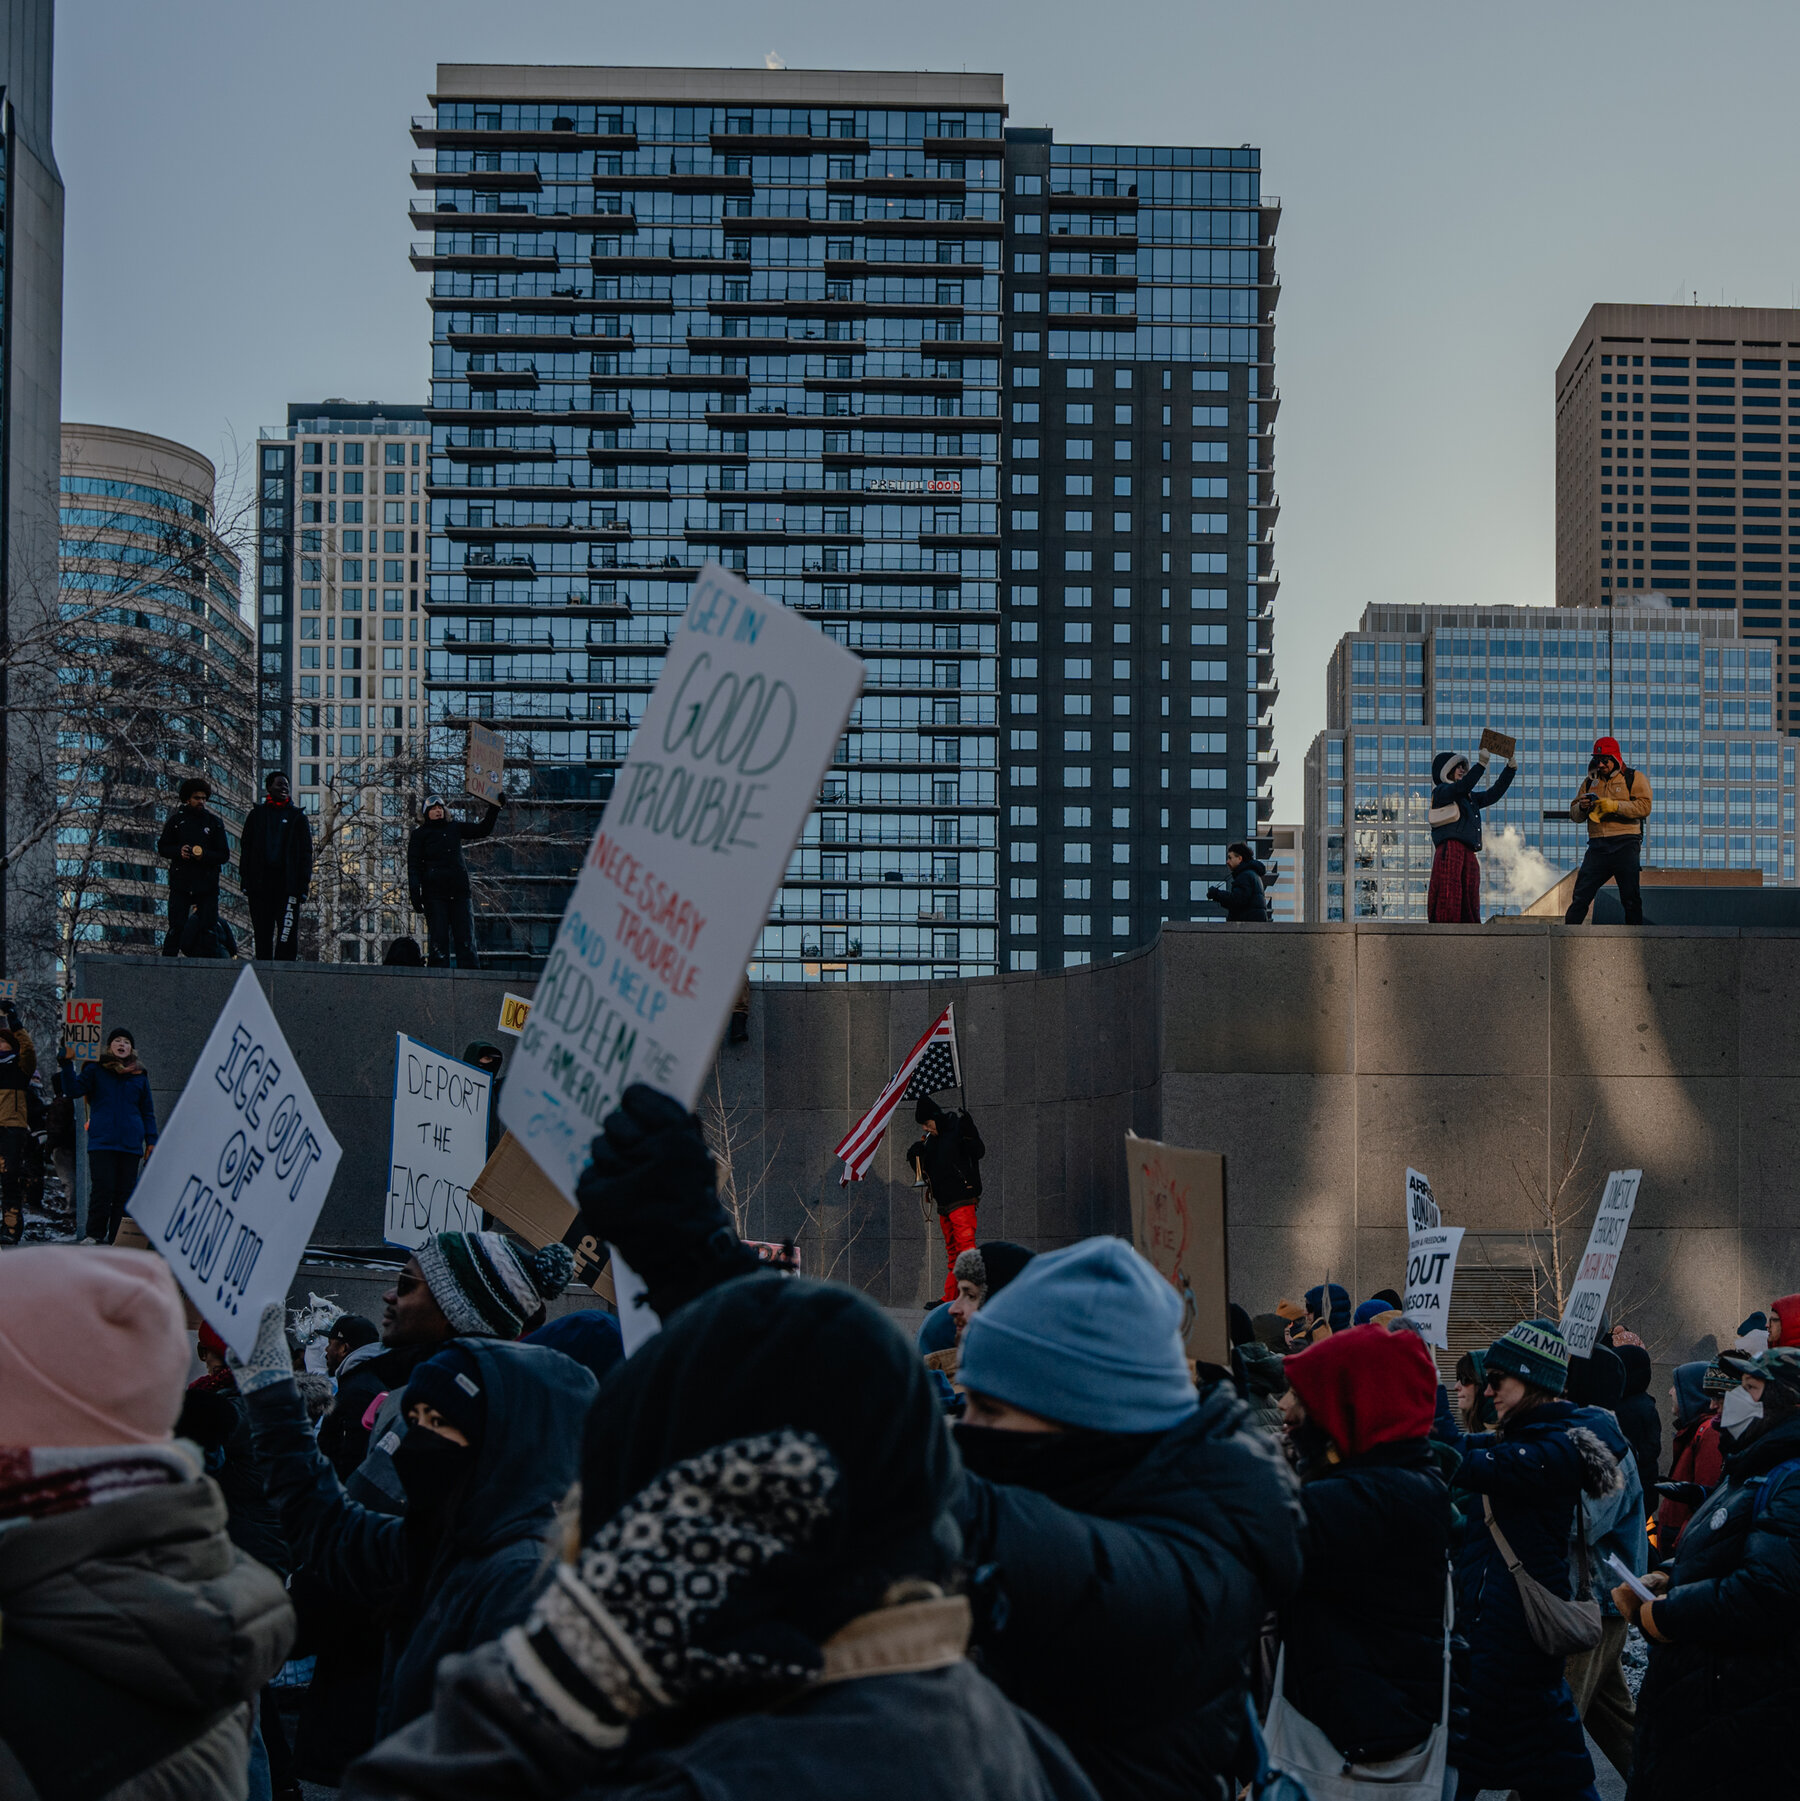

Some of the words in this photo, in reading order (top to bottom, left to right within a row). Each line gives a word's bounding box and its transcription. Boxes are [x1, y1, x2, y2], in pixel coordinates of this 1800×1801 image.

[870, 479, 923, 490] PRETTI
[927, 480, 961, 491] GOOD
[687, 579, 738, 637] GET
[733, 605, 768, 645] IN
[662, 651, 797, 776] GOOD
[618, 761, 770, 855] TROUBLE
[280, 895, 297, 943] BLADES
[590, 832, 707, 951] NECESSARY
[562, 911, 607, 968] AND
[609, 957, 667, 1022] HELP
[615, 902, 701, 999] TROUBLE
[66, 1024, 100, 1043] MELTS
[67, 1002, 102, 1024] LOVE
[534, 947, 638, 1094] REDEEM
[644, 1036, 680, 1084] THE
[408, 1054, 486, 1115] DEPORT
[521, 1022, 549, 1057] OF
[543, 1042, 618, 1128] AMERIC
[214, 1021, 280, 1131] ICE
[266, 1093, 322, 1201] OUT
[417, 1122, 452, 1153] THE
[217, 1130, 264, 1201] OF
[1409, 1253, 1450, 1287] OUT
